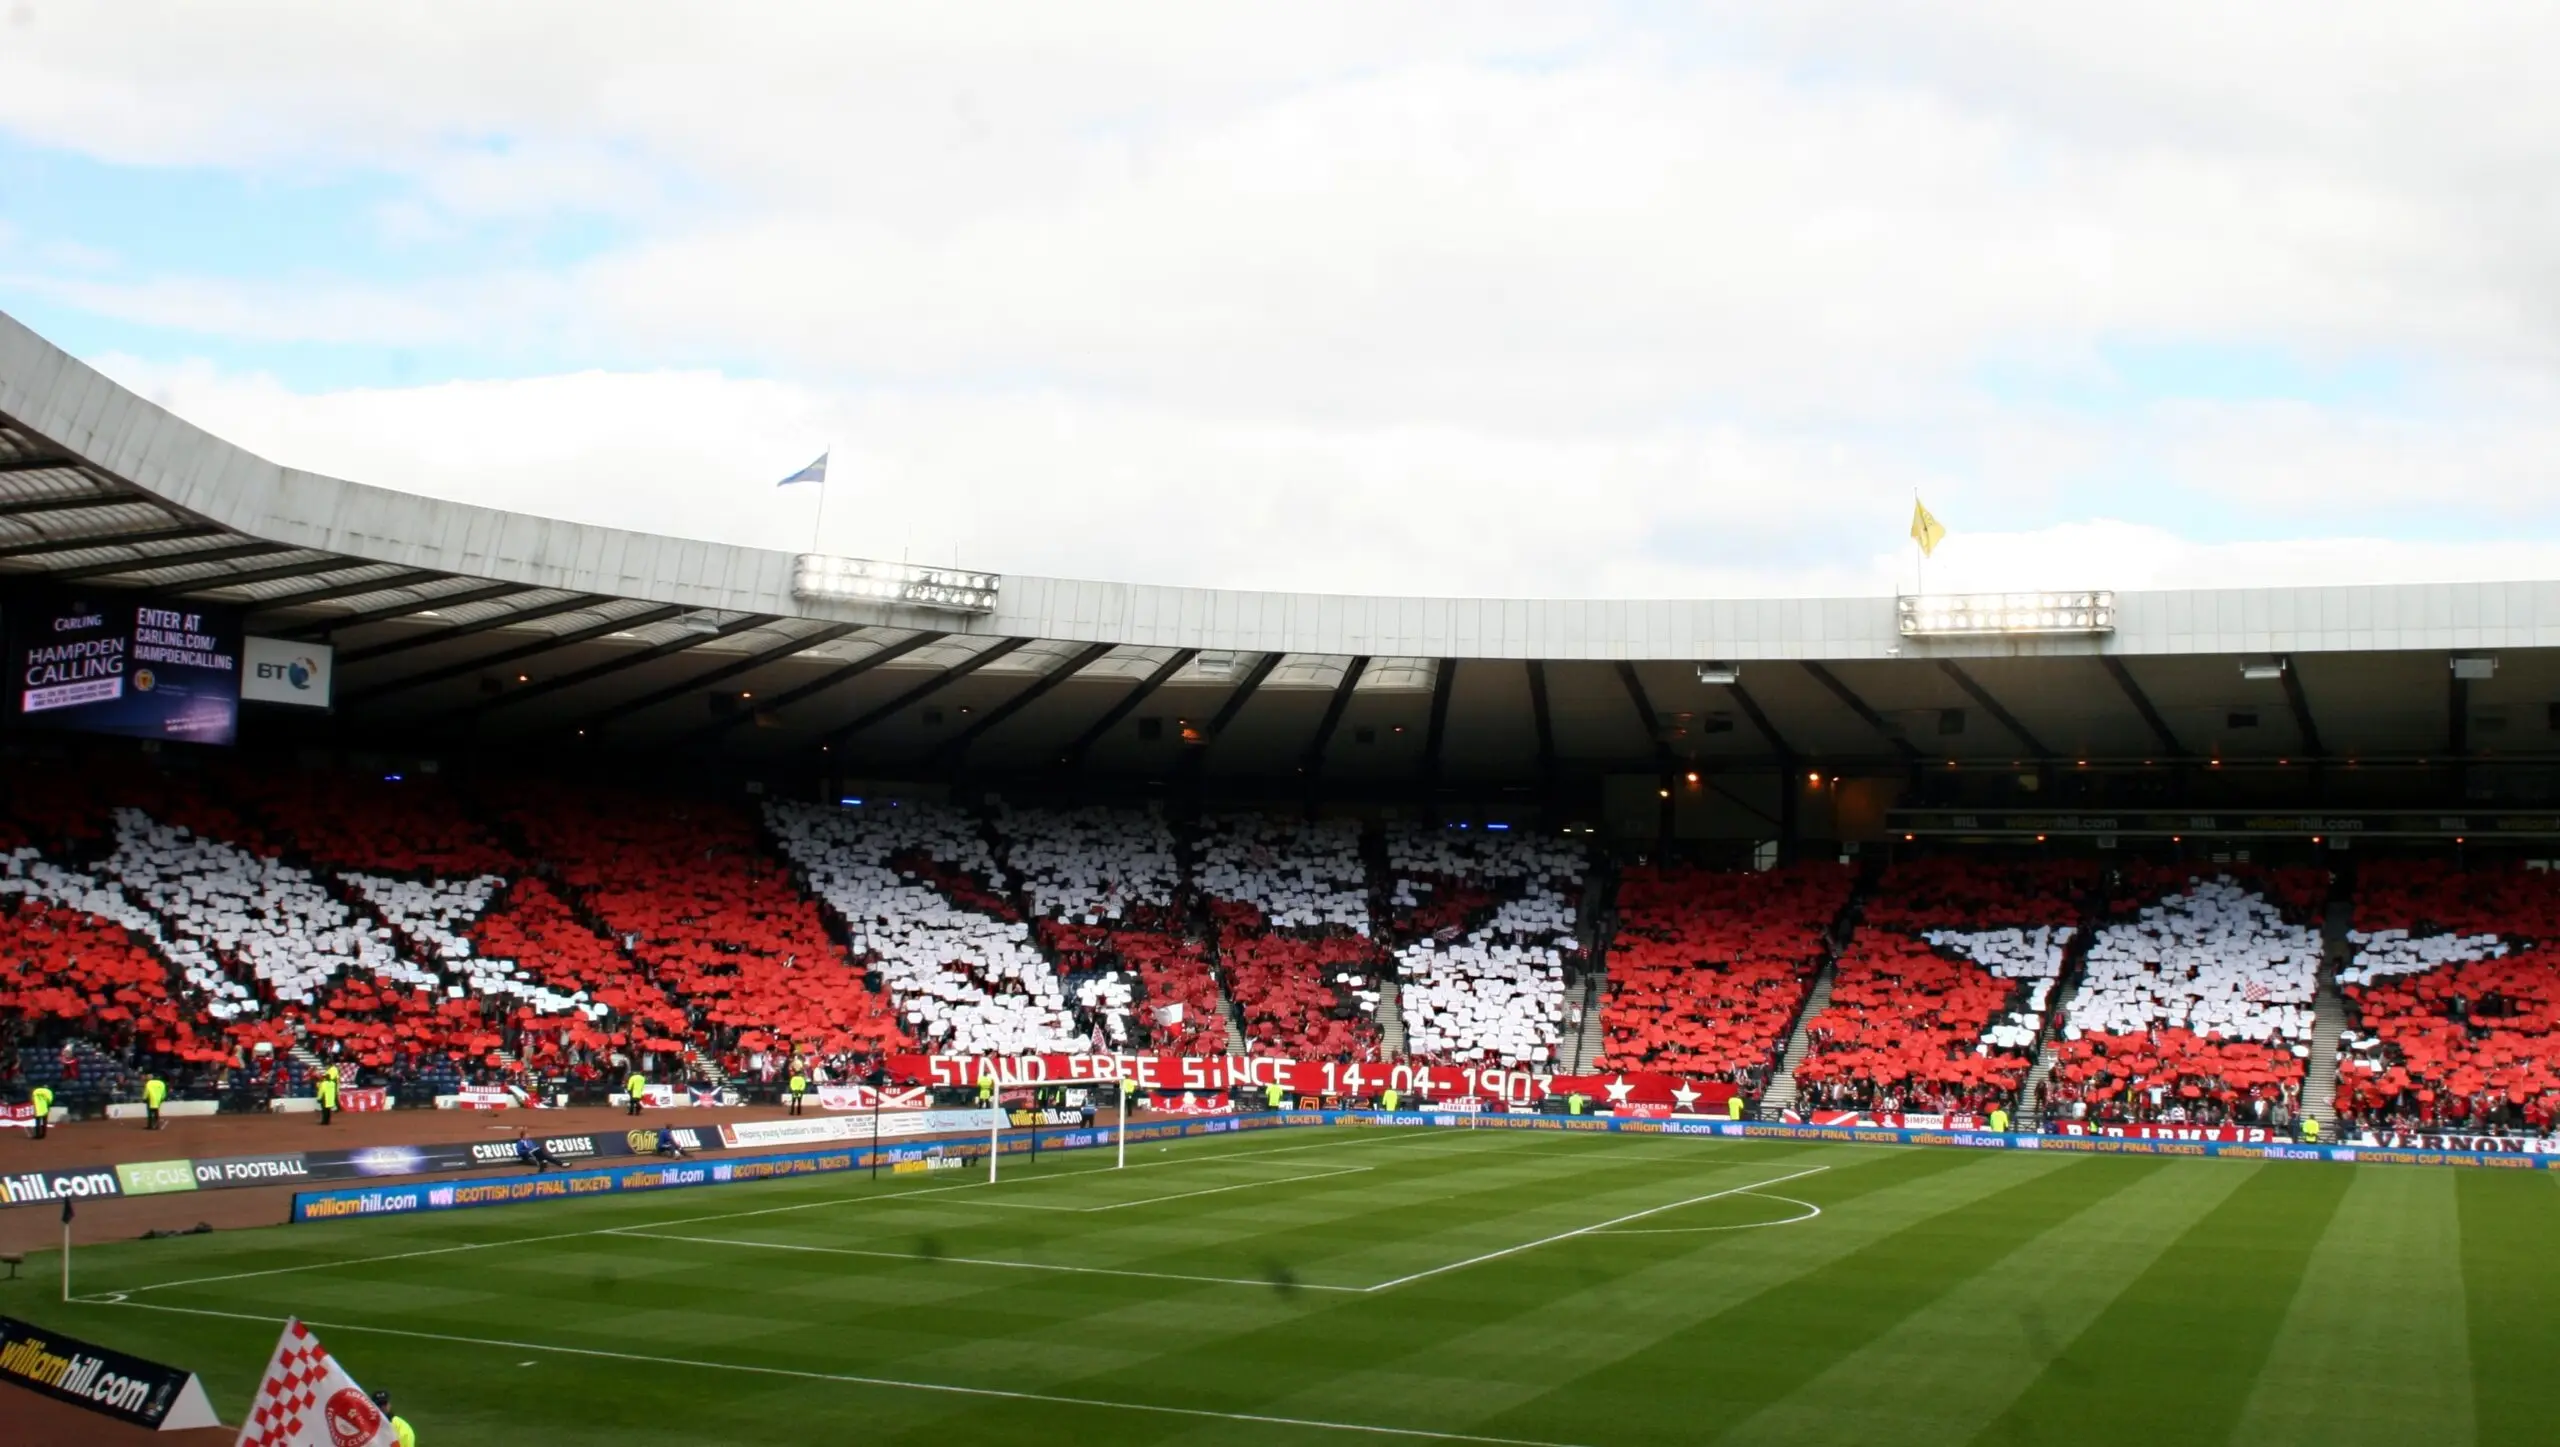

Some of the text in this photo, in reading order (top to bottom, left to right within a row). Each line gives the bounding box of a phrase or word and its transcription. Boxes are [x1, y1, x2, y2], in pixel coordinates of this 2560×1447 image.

[54, 614, 102, 631] CARLING
[137, 607, 201, 632] ENTER AT
[135, 627, 217, 650] CARLING.COM/
[28, 637, 125, 665] HAMPDEN
[134, 645, 233, 670] HAMPDENCALLING
[26, 655, 124, 685] CALLING
[257, 662, 288, 681] BT
[930, 1055, 1047, 1086] STAND
[1069, 1055, 1161, 1088] FREE
[1182, 1056, 1296, 1091] SINCE
[1615, 1102, 1668, 1110] ABERDEEN
[1009, 1107, 1083, 1126] williamhill.com
[1334, 1114, 1423, 1126] williamhill.com
[1434, 1115, 1608, 1131] WIN SCOTTISH CUP FINAL TICKETS
[1905, 1115, 1943, 1125] SIMPSON
[1620, 1120, 1711, 1134] williamhill.com
[1721, 1124, 1899, 1142] WIN SCOTTISH CUP FINAL TICKETS
[545, 1137, 593, 1153] CRUISE
[1910, 1132, 2005, 1147] williamhill.com
[2016, 1136, 2205, 1155] WIN SCOTTISH CUP FINAL TICKETS
[2372, 1132, 2526, 1152] VERNON
[2218, 1145, 2320, 1160] williamhill.com
[2331, 1148, 2533, 1168] WIN SCOTTISH CUP FINAL TICKETS
[130, 1159, 308, 1187] FOCUS ON FOOTBALL
[713, 1155, 851, 1180] WIN SCOTTISH CUP FINAL TICKETS
[622, 1168, 705, 1188] williamhill.com
[429, 1176, 612, 1205] WIN SCOTTISH CUP FINAL TICKETS
[305, 1194, 418, 1218] williamhill.com
[0, 1337, 150, 1413] williamhill.com
